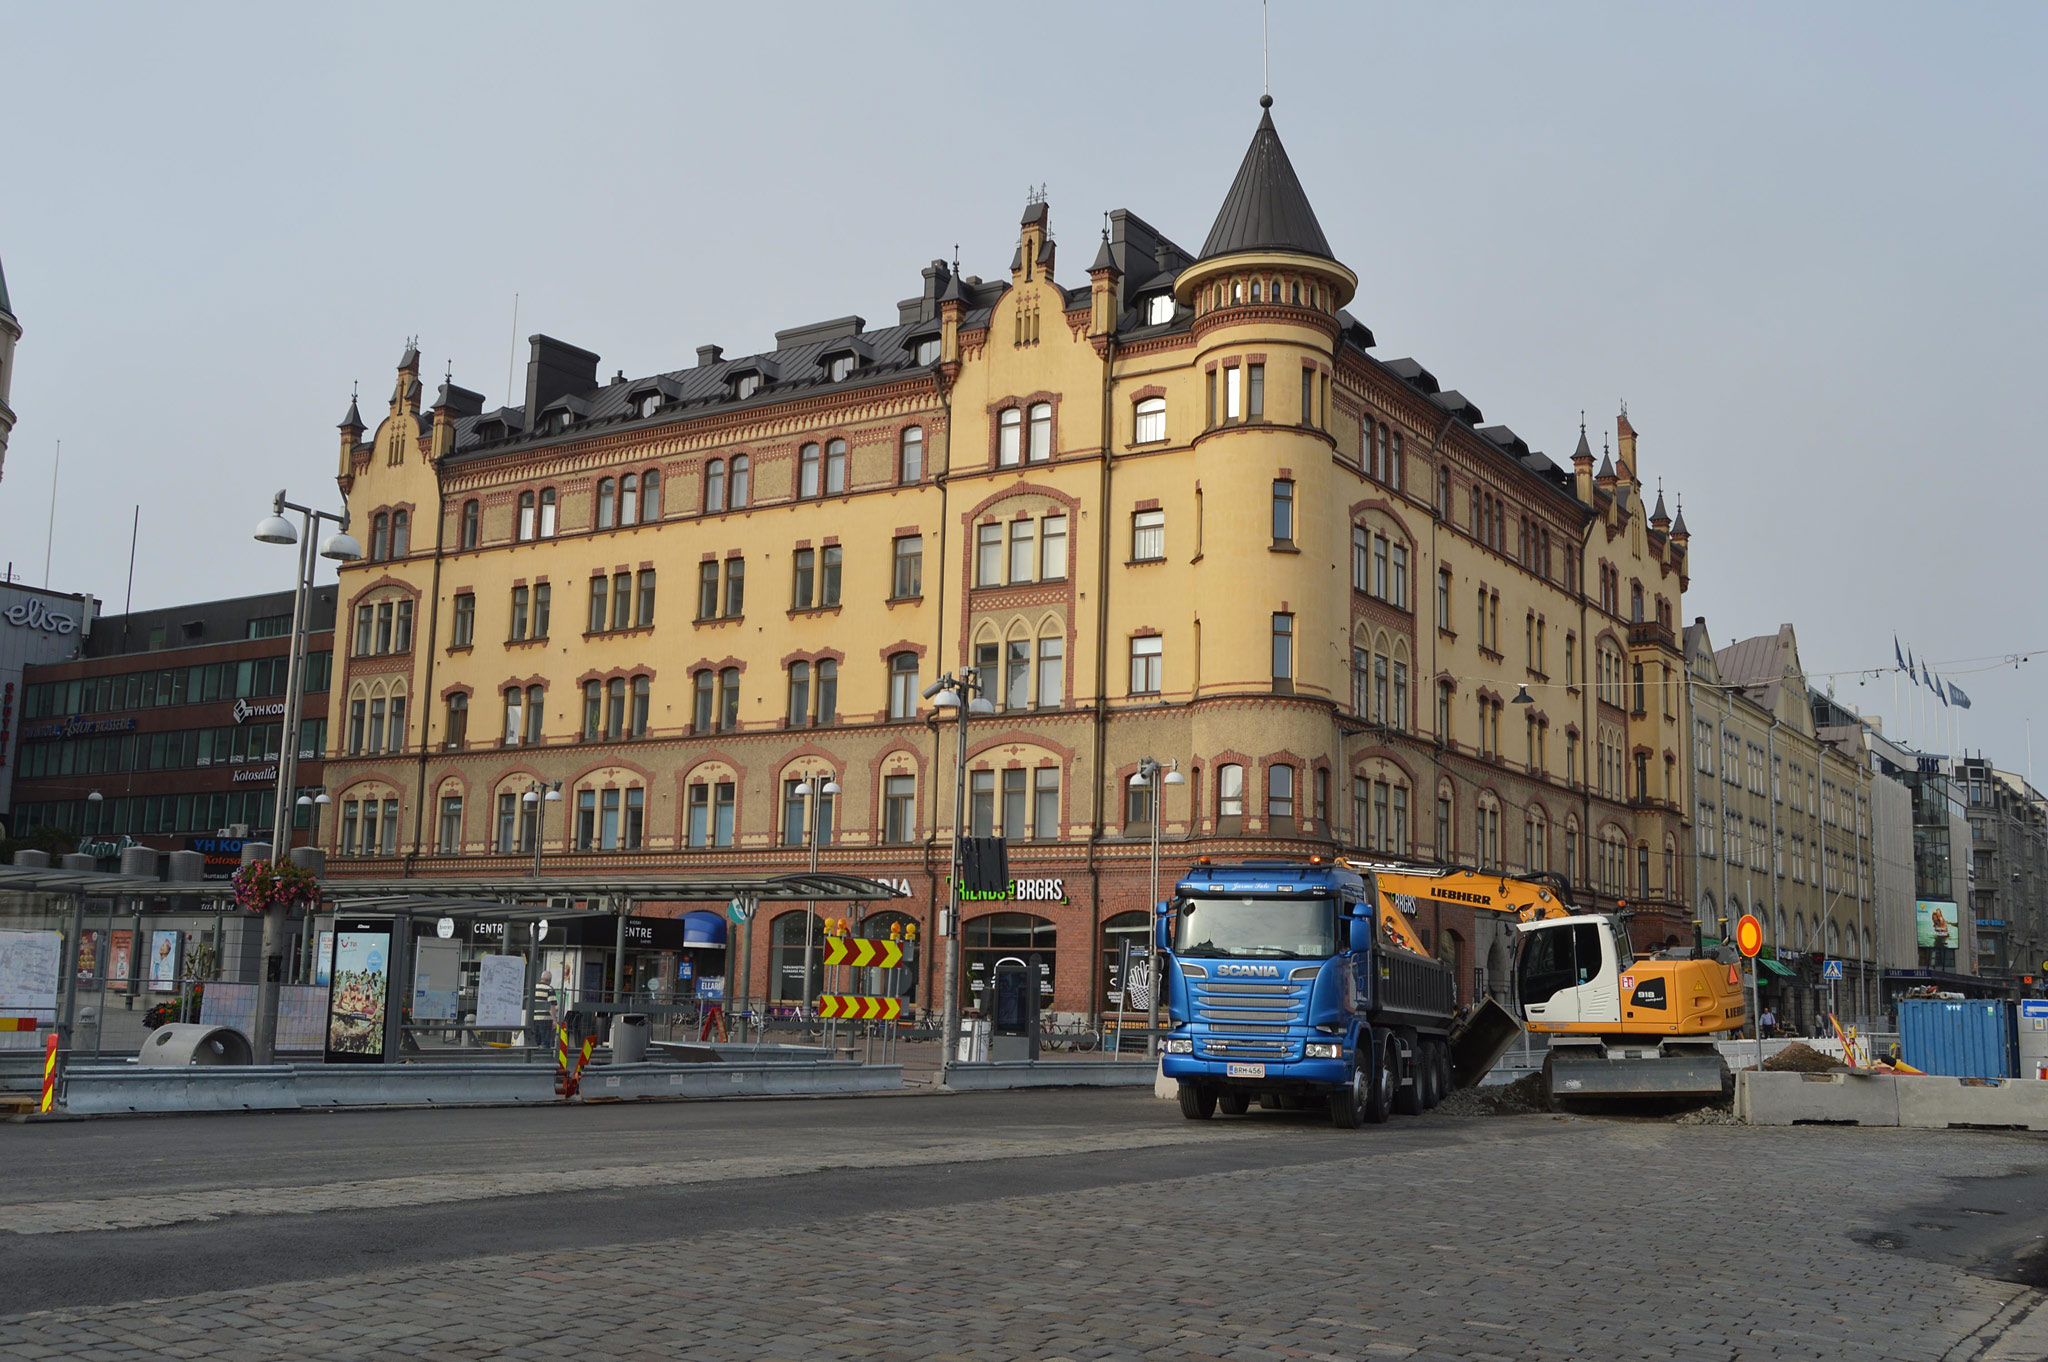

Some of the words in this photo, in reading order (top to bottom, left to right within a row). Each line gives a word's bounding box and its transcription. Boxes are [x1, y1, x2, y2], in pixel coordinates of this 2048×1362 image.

[3, 598, 78, 634] elisa
[266, 703, 286, 715] KOD
[233, 766, 277, 782] Kotosalla
[203, 855, 242, 865] Kotosa
[1017, 879, 1064, 901] BRGRS
[1431, 887, 1492, 905] LIEBHERR
[474, 923, 504, 934] CENTR
[624, 926, 653, 938] ENTRE
[1217, 964, 1280, 977] SCANIA
